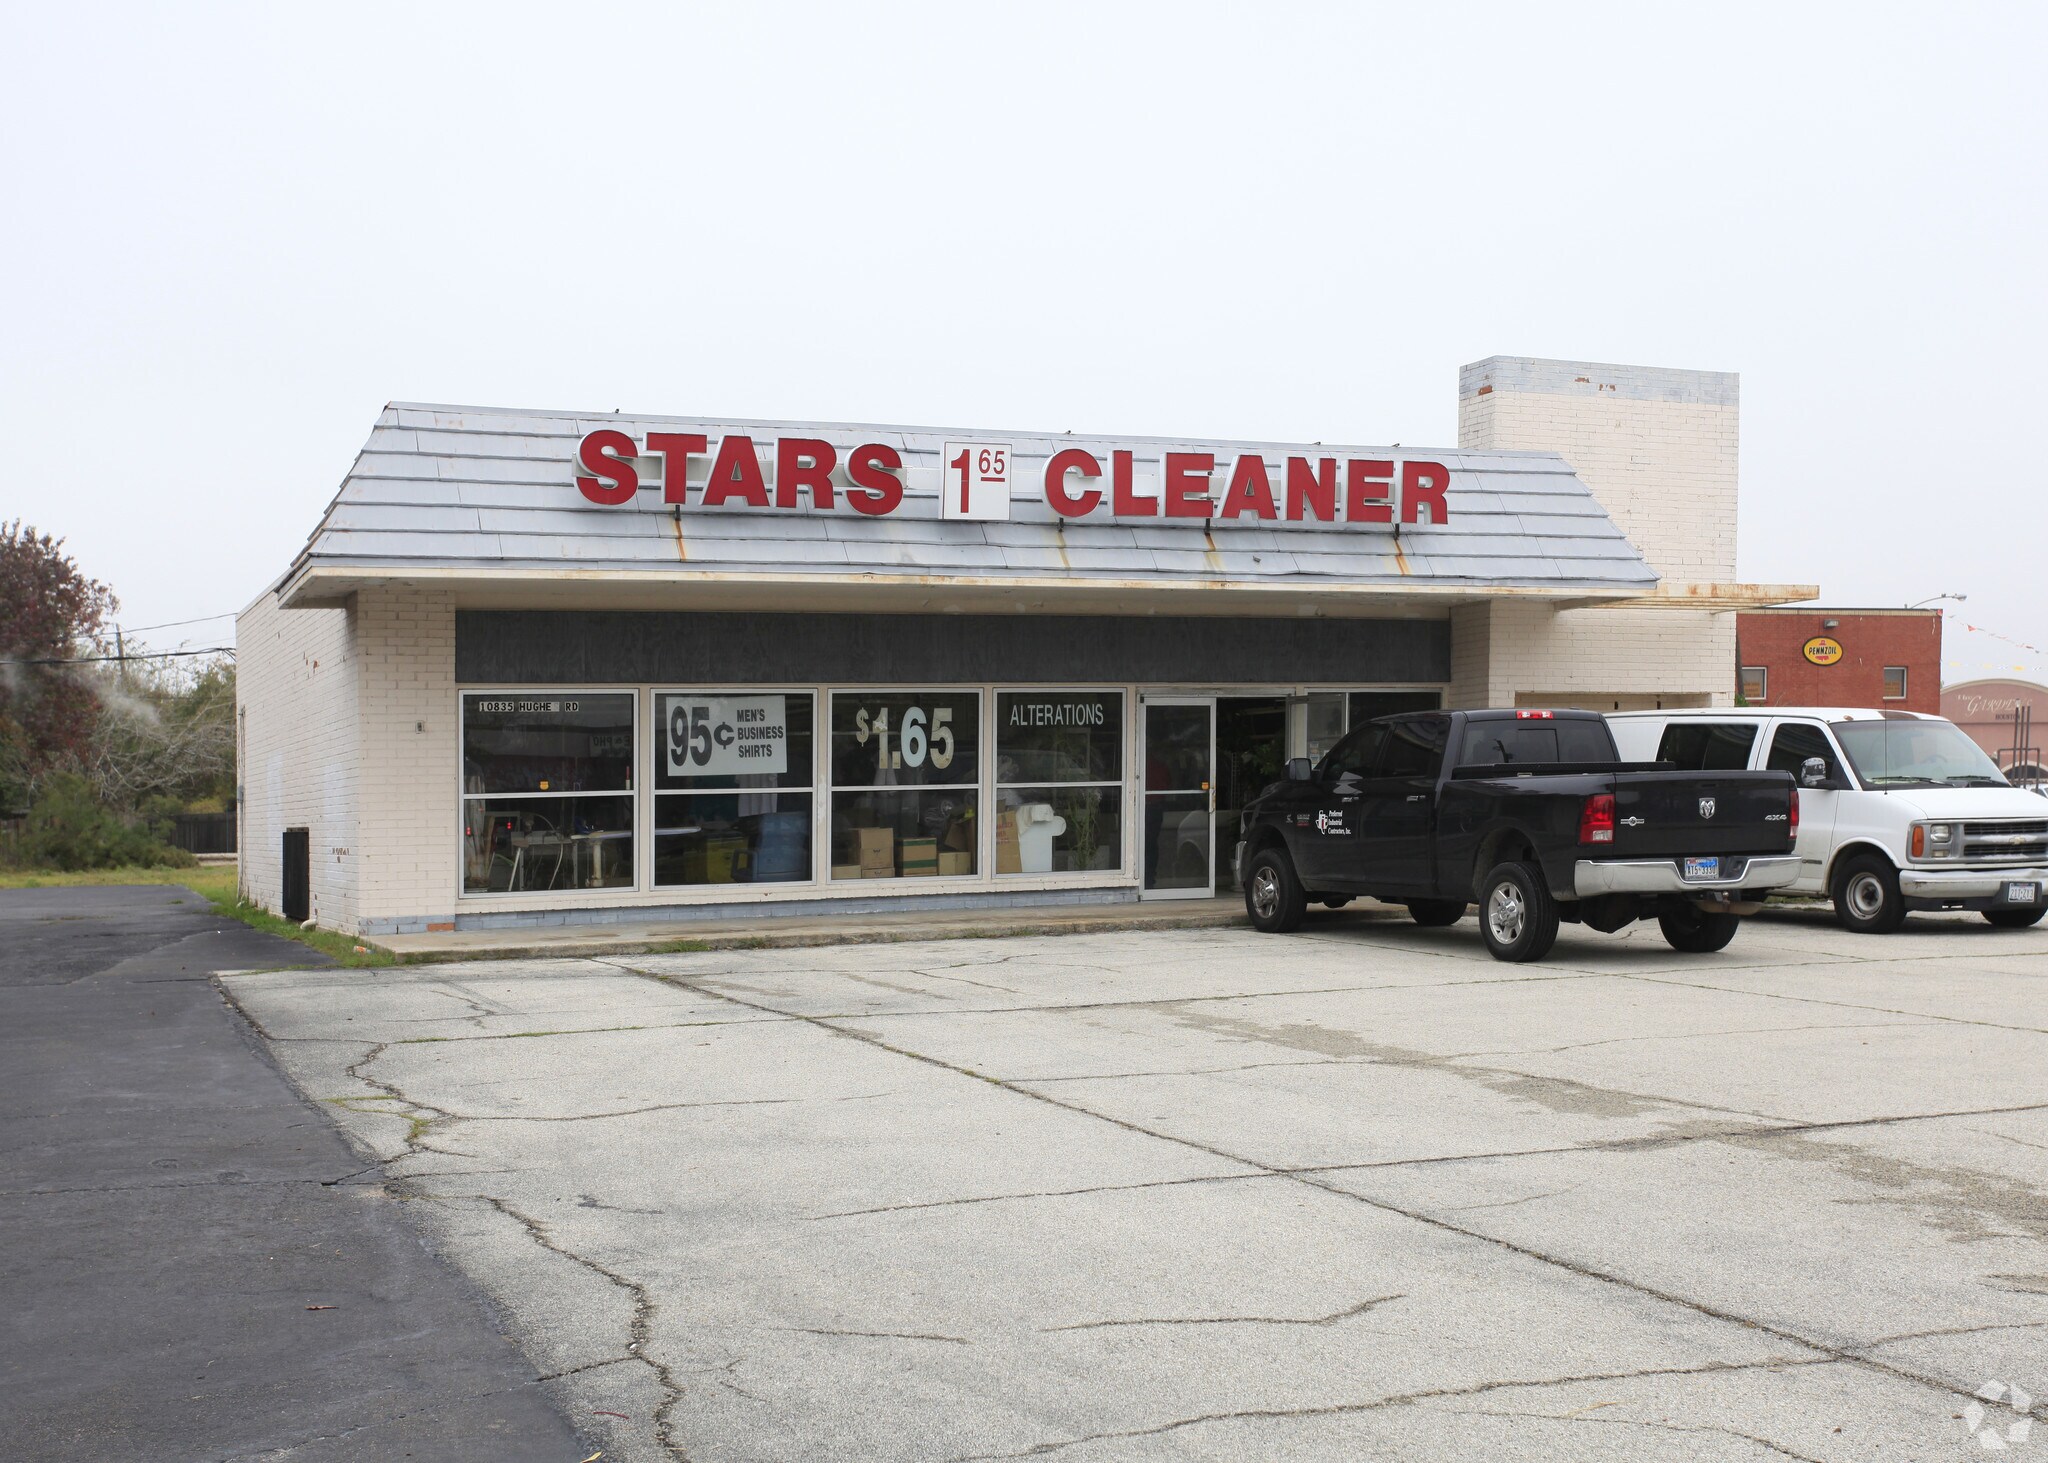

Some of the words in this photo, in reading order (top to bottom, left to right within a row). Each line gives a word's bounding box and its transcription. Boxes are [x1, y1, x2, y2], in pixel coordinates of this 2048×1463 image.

[575, 429, 904, 516] STARS
[1041, 448, 1451, 526] CLEANER
[1808, 646, 1837, 655] PENNZOIL
[480, 702, 514, 712] 10835
[519, 702, 558, 712] HUGHE
[565, 702, 578, 712] RD
[1009, 703, 1104, 726] ALTERATIONS
[736, 708, 766, 723] MEN'S
[737, 725, 784, 740] BUSINESS
[855, 706, 955, 769] $1.65
[738, 744, 773, 758] SHIRTS
